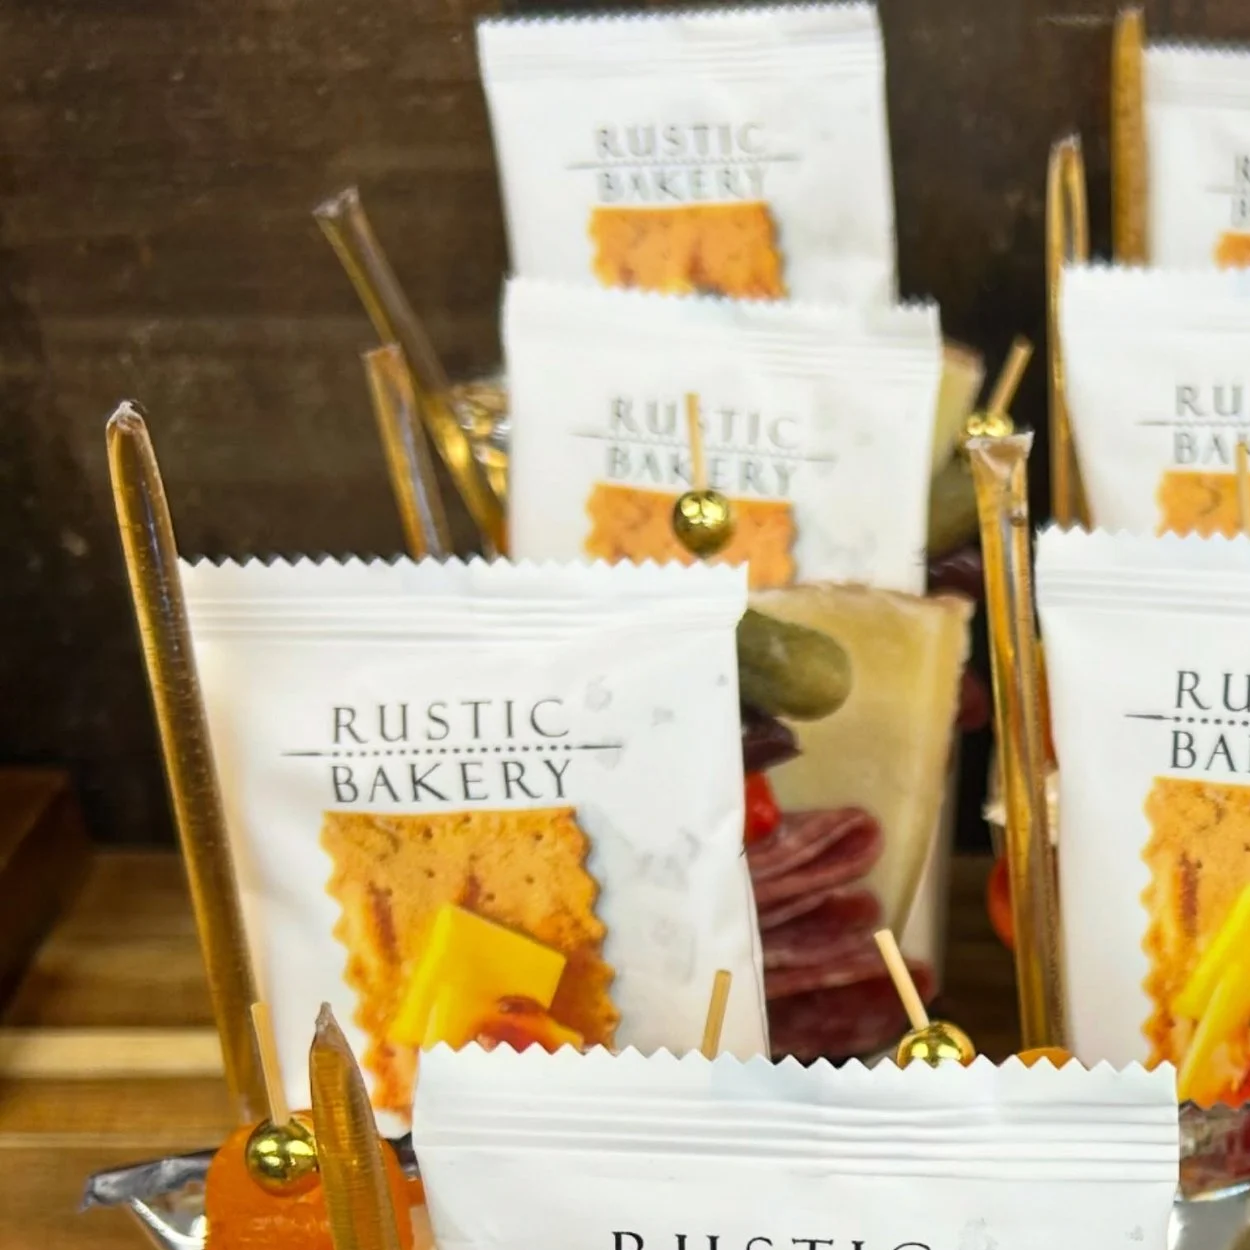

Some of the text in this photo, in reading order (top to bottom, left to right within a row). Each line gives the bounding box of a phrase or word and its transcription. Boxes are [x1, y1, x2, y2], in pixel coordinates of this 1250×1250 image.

[595, 122, 768, 158] RUSTIC
[596, 168, 768, 202] BAKERY
[609, 397, 801, 450] RUTIC
[332, 698, 570, 743] RUSTIC
[332, 758, 572, 804] BAKERY
